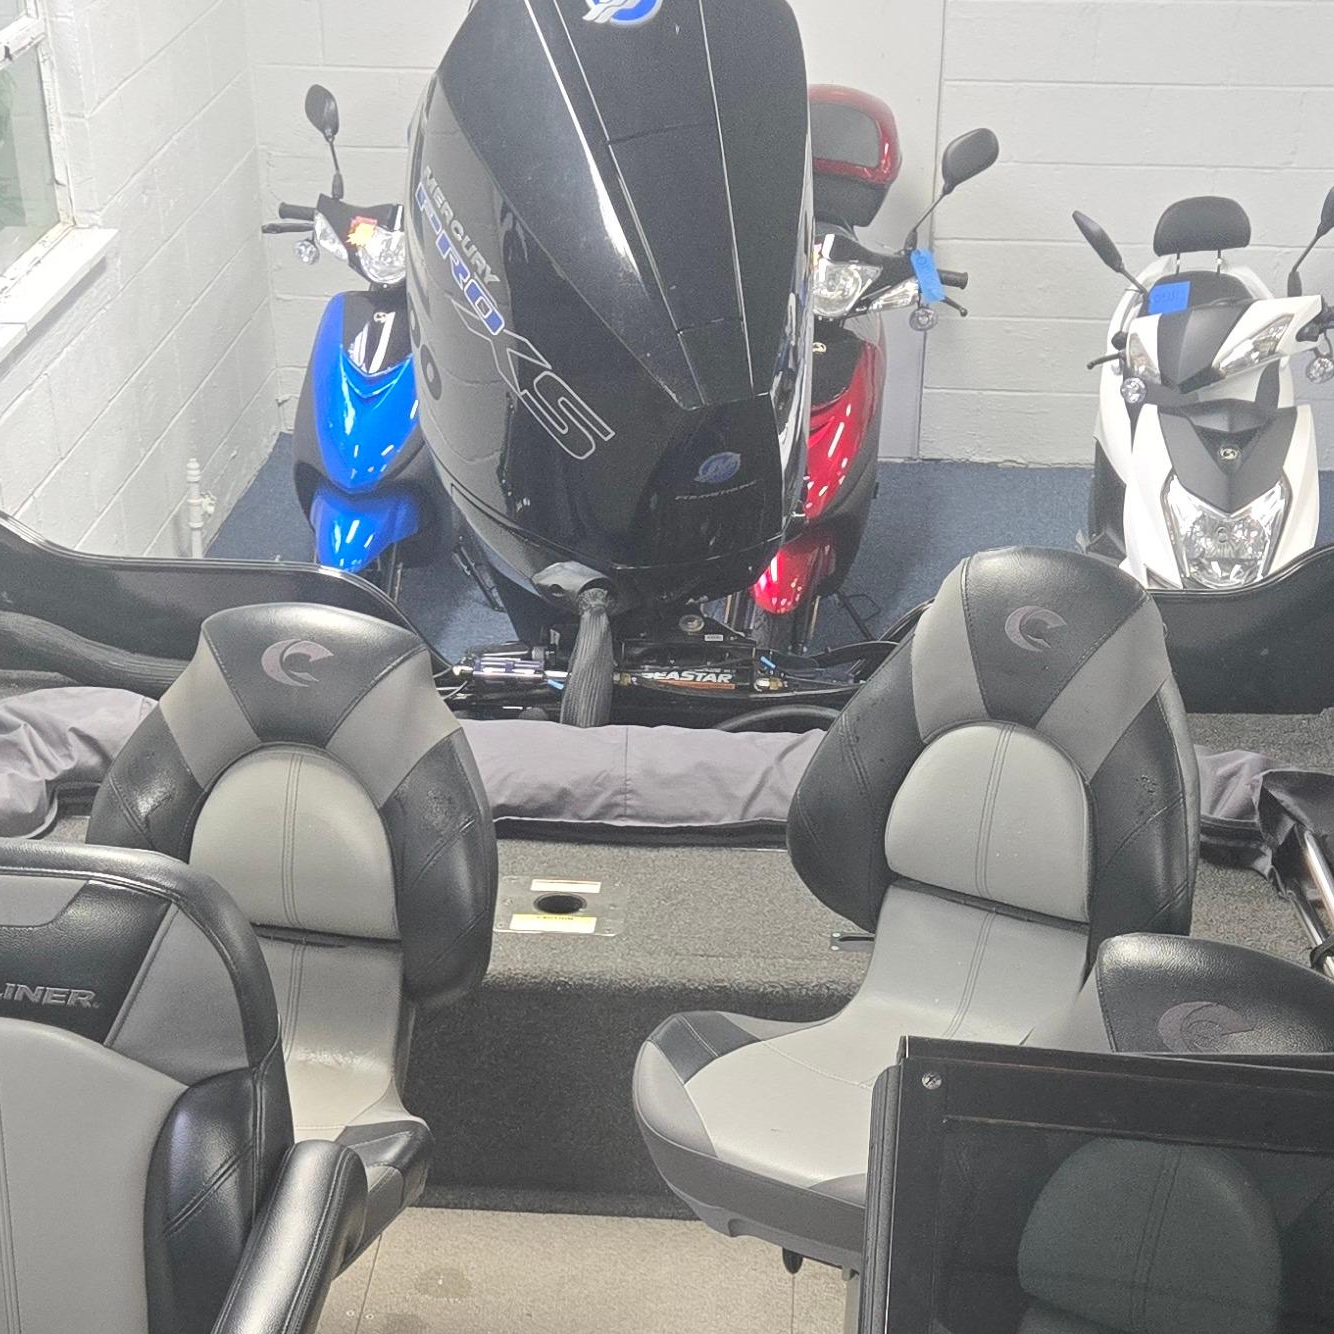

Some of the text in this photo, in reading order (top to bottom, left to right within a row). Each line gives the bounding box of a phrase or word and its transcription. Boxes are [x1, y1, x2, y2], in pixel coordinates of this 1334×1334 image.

[415, 181, 616, 460] PRO XS
[423, 165, 500, 284] MERCURY
